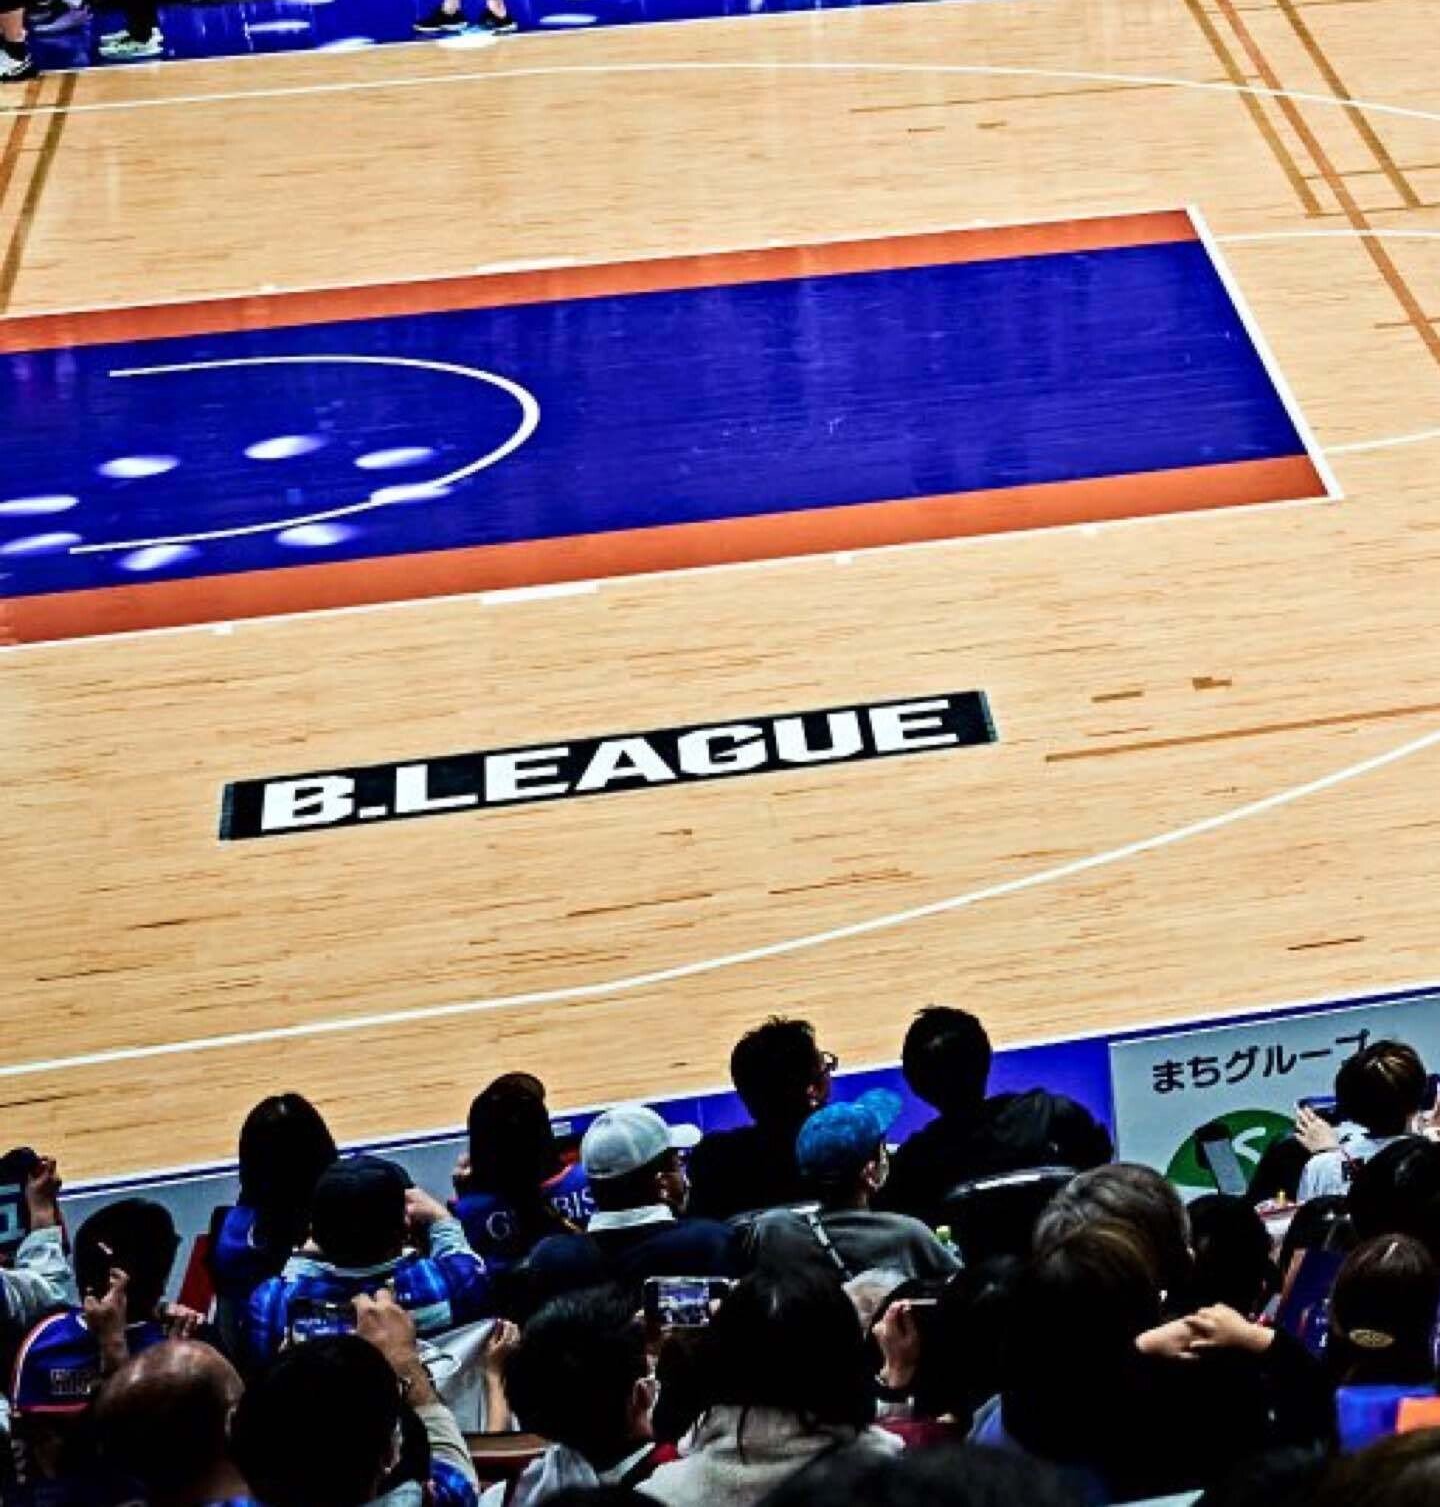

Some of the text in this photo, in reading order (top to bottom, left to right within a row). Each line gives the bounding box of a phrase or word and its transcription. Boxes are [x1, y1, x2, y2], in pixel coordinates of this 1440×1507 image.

[259, 697, 963, 835] B.LEAGUE
[1150, 1028, 1371, 1093] まちグループ
